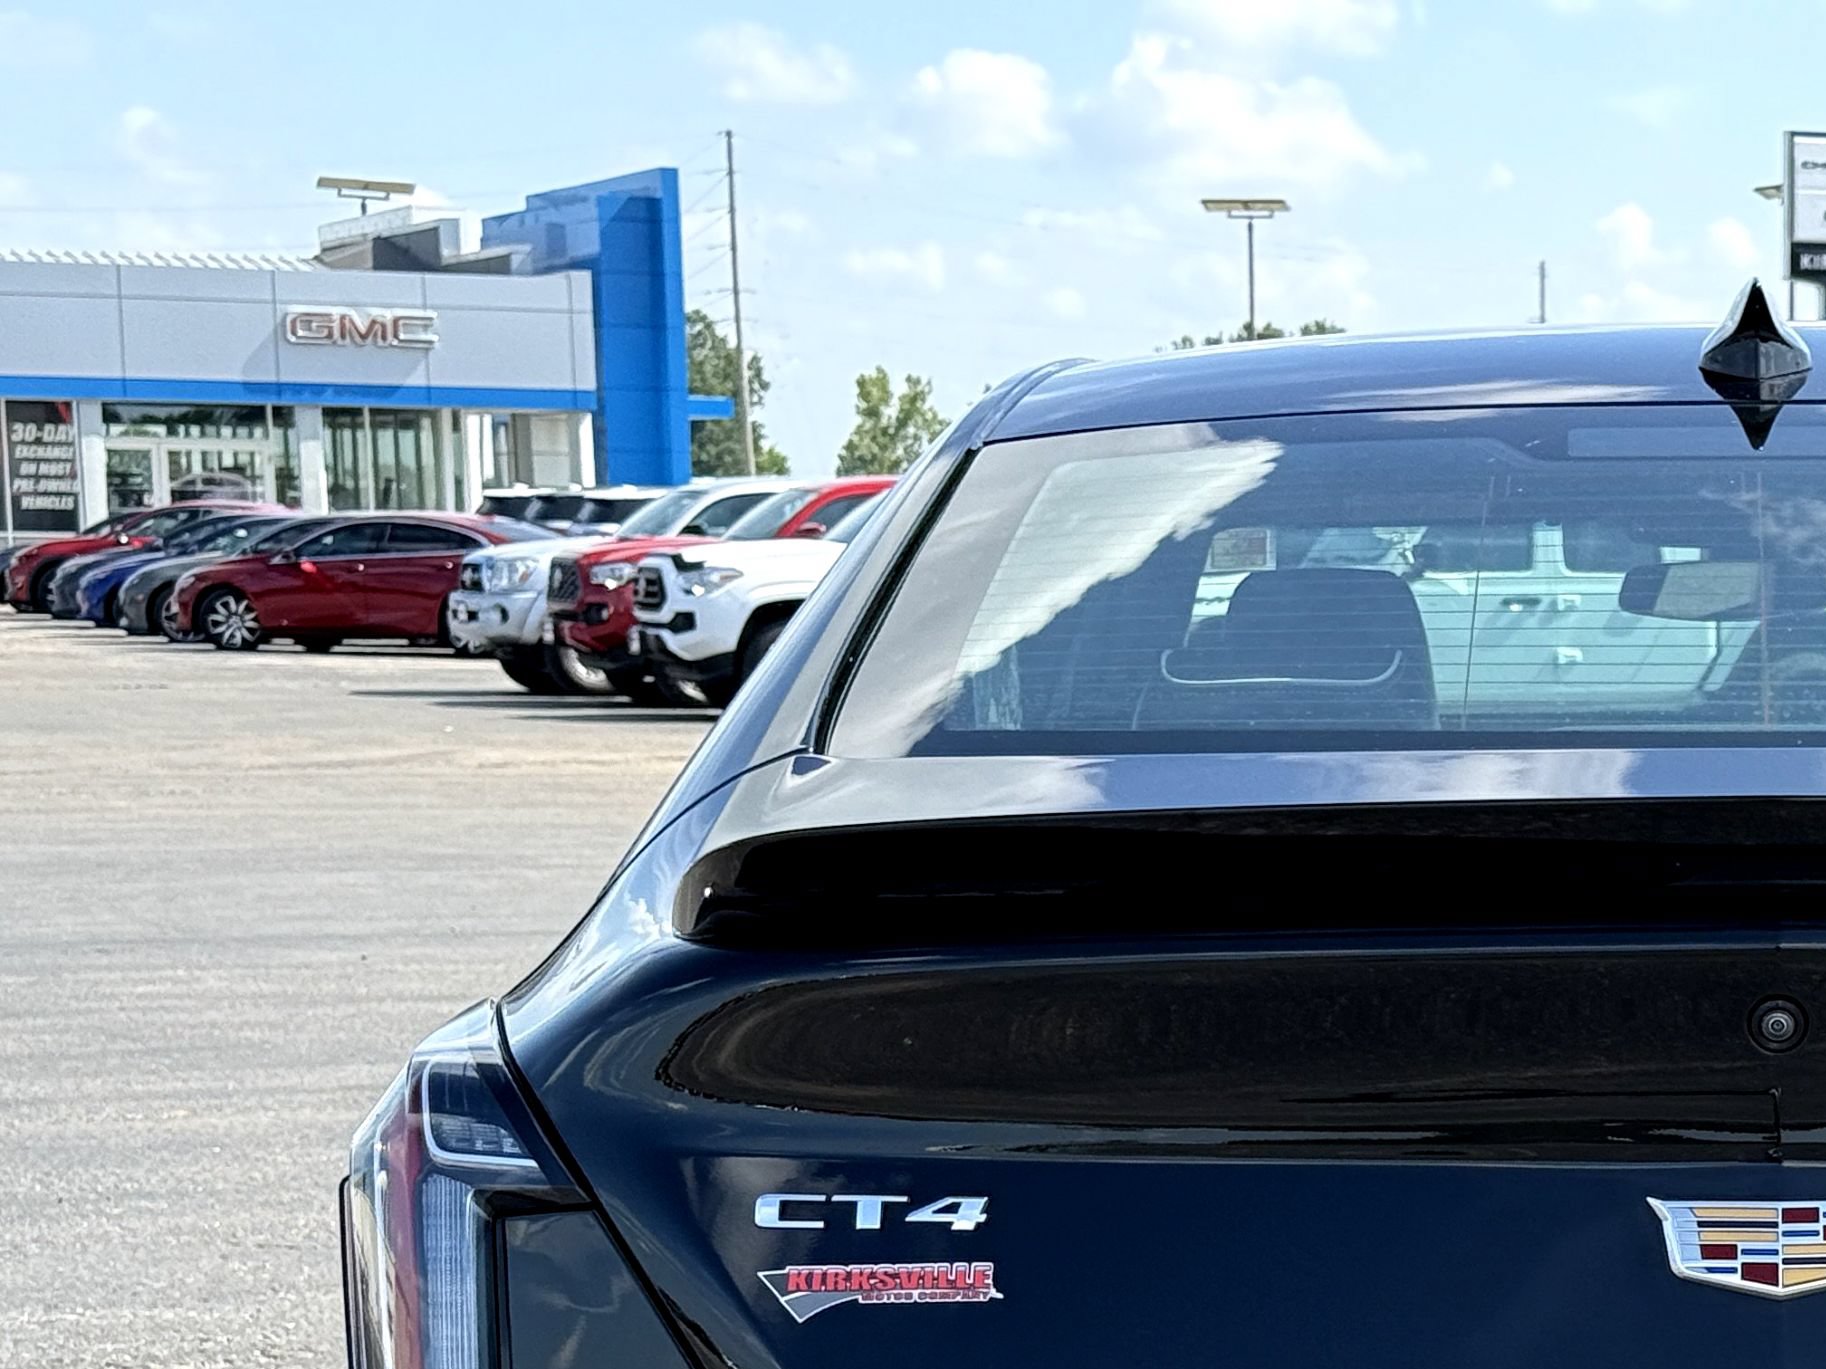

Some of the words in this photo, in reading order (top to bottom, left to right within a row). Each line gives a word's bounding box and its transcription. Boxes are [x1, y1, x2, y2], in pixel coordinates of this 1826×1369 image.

[286, 305, 439, 348] GMC
[20, 494, 75, 510] VEHICLES
[754, 1193, 989, 1231] CT4
[786, 1264, 993, 1292] KIRKSVILLE
[861, 1291, 914, 1301] MOTOR
[917, 1290, 990, 1301] COMPANY
